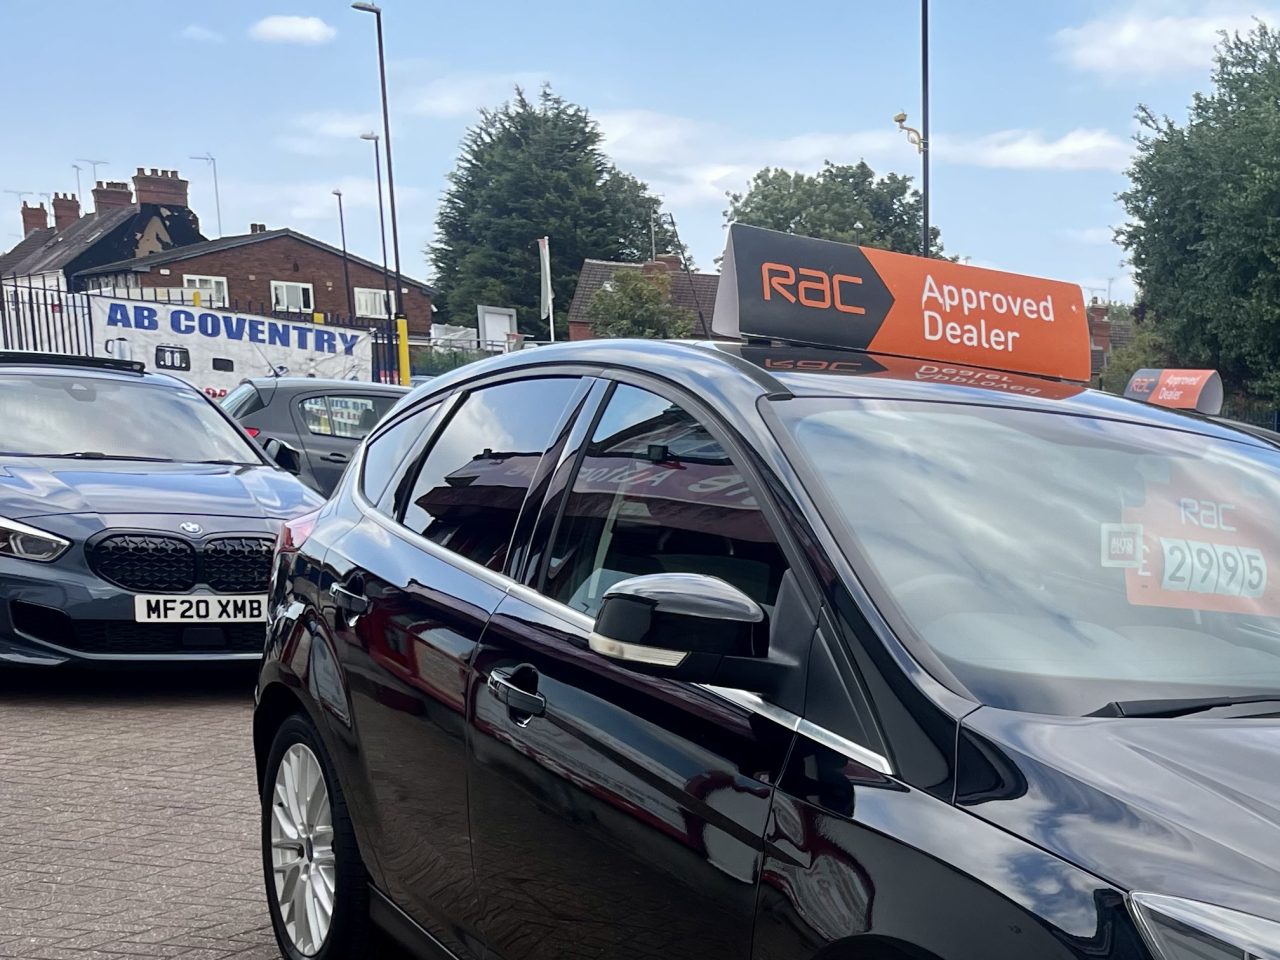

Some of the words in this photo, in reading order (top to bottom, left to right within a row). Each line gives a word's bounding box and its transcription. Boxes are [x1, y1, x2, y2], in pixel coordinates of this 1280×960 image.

[921, 274, 1055, 322] Approved
[107, 303, 158, 331] AB
[170, 309, 360, 356] COVENTRY
[923, 310, 1020, 352] Dealer
[1158, 387, 1184, 400] Dealer
[1165, 374, 1201, 388] Approved
[1168, 544, 1264, 591] 2995
[146, 599, 210, 619] MF20
[217, 599, 262, 619] XMB
